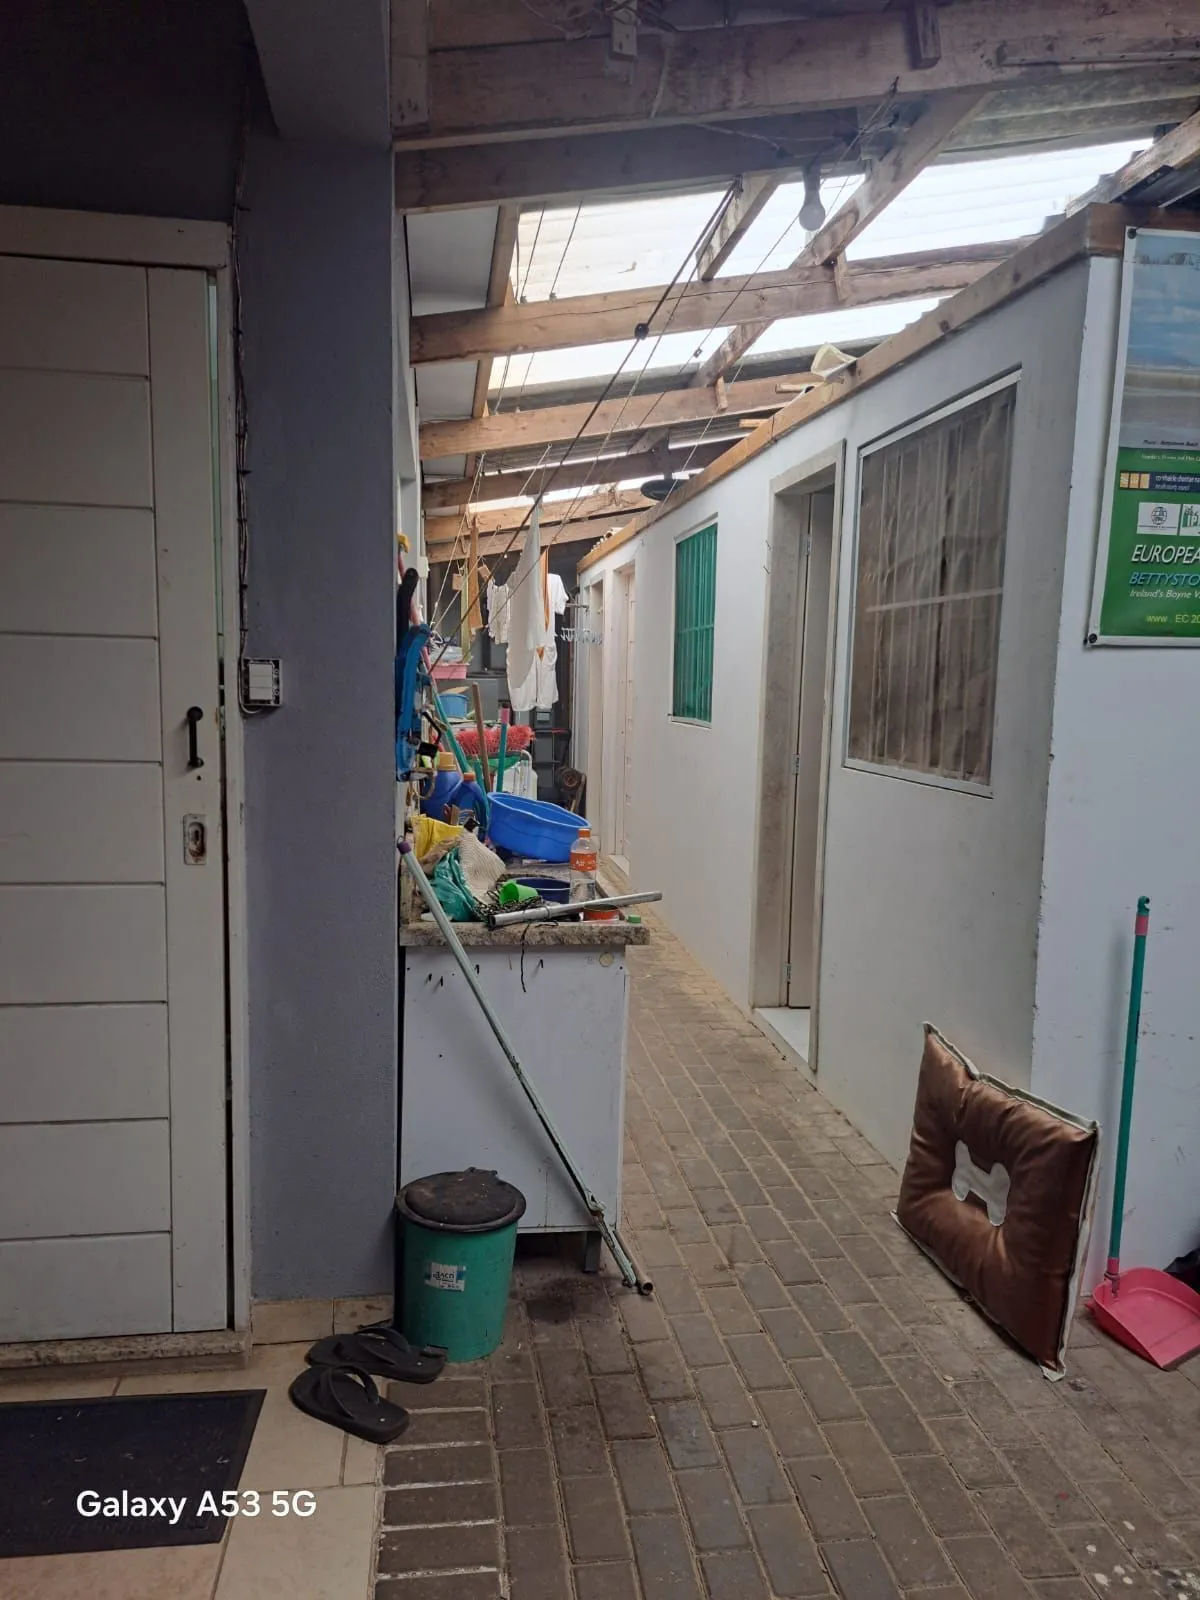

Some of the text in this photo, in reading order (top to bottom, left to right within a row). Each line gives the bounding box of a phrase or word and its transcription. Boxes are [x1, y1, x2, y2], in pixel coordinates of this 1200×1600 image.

[1131, 543, 1200, 564] EUROPEA
[1129, 571, 1200, 586] BETTYSTO
[1130, 589, 1163, 598] Ireland's
[1165, 589, 1192, 600] Boyne
[1175, 614, 1190, 624] EC
